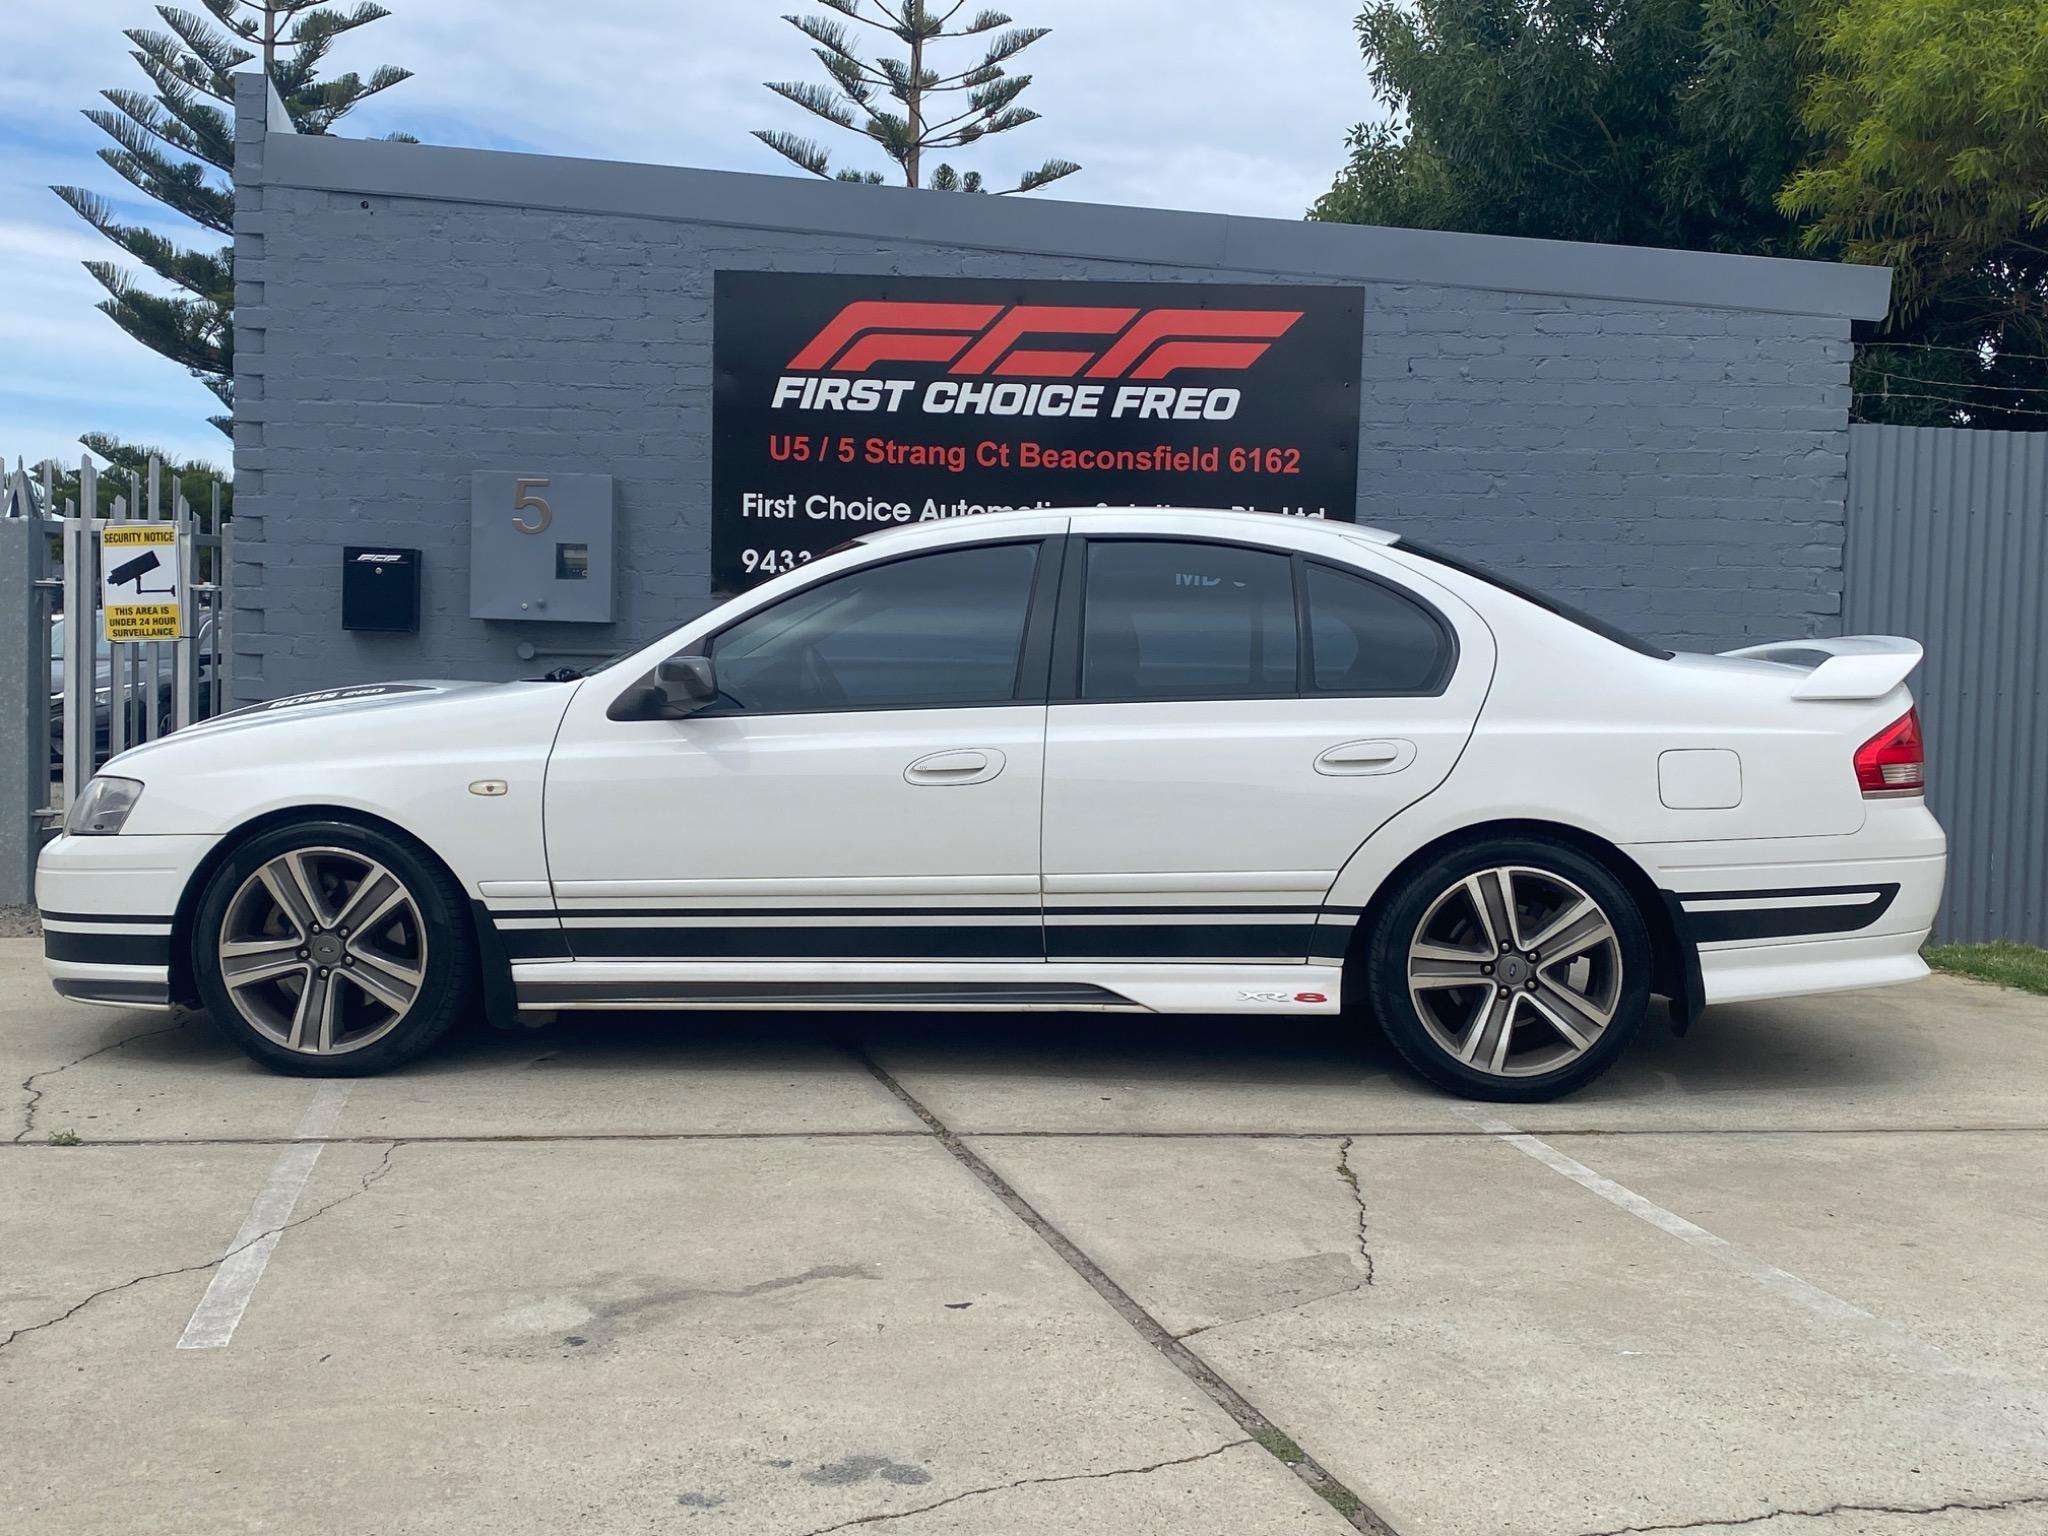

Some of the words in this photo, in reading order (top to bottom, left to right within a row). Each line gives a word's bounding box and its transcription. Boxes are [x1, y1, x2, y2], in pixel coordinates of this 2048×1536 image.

[771, 376, 915, 413] FIRST
[921, 381, 1101, 418] CHOICE
[1110, 386, 1242, 420] FREO
[769, 435, 811, 463] U5
[817, 437, 828, 462] /
[838, 437, 856, 463] 5
[864, 437, 967, 473] Strang
[976, 440, 1010, 468] Ct
[1020, 442, 1219, 473] Beaconsfield
[1229, 447, 1301, 474] 6162
[512, 479, 552, 534] 5
[742, 493, 797, 518] First
[805, 494, 911, 522] Choice
[104, 532, 142, 543] SECURITY
[144, 531, 175, 542] NOTICE
[115, 607, 133, 616] THIS
[135, 606, 158, 615] AREA
[161, 606, 169, 615] IS
[109, 619, 137, 627] UNDER
[140, 618, 150, 626] 24
[152, 617, 176, 626] HOUR
[112, 628, 175, 637] SURVEILLANCE
